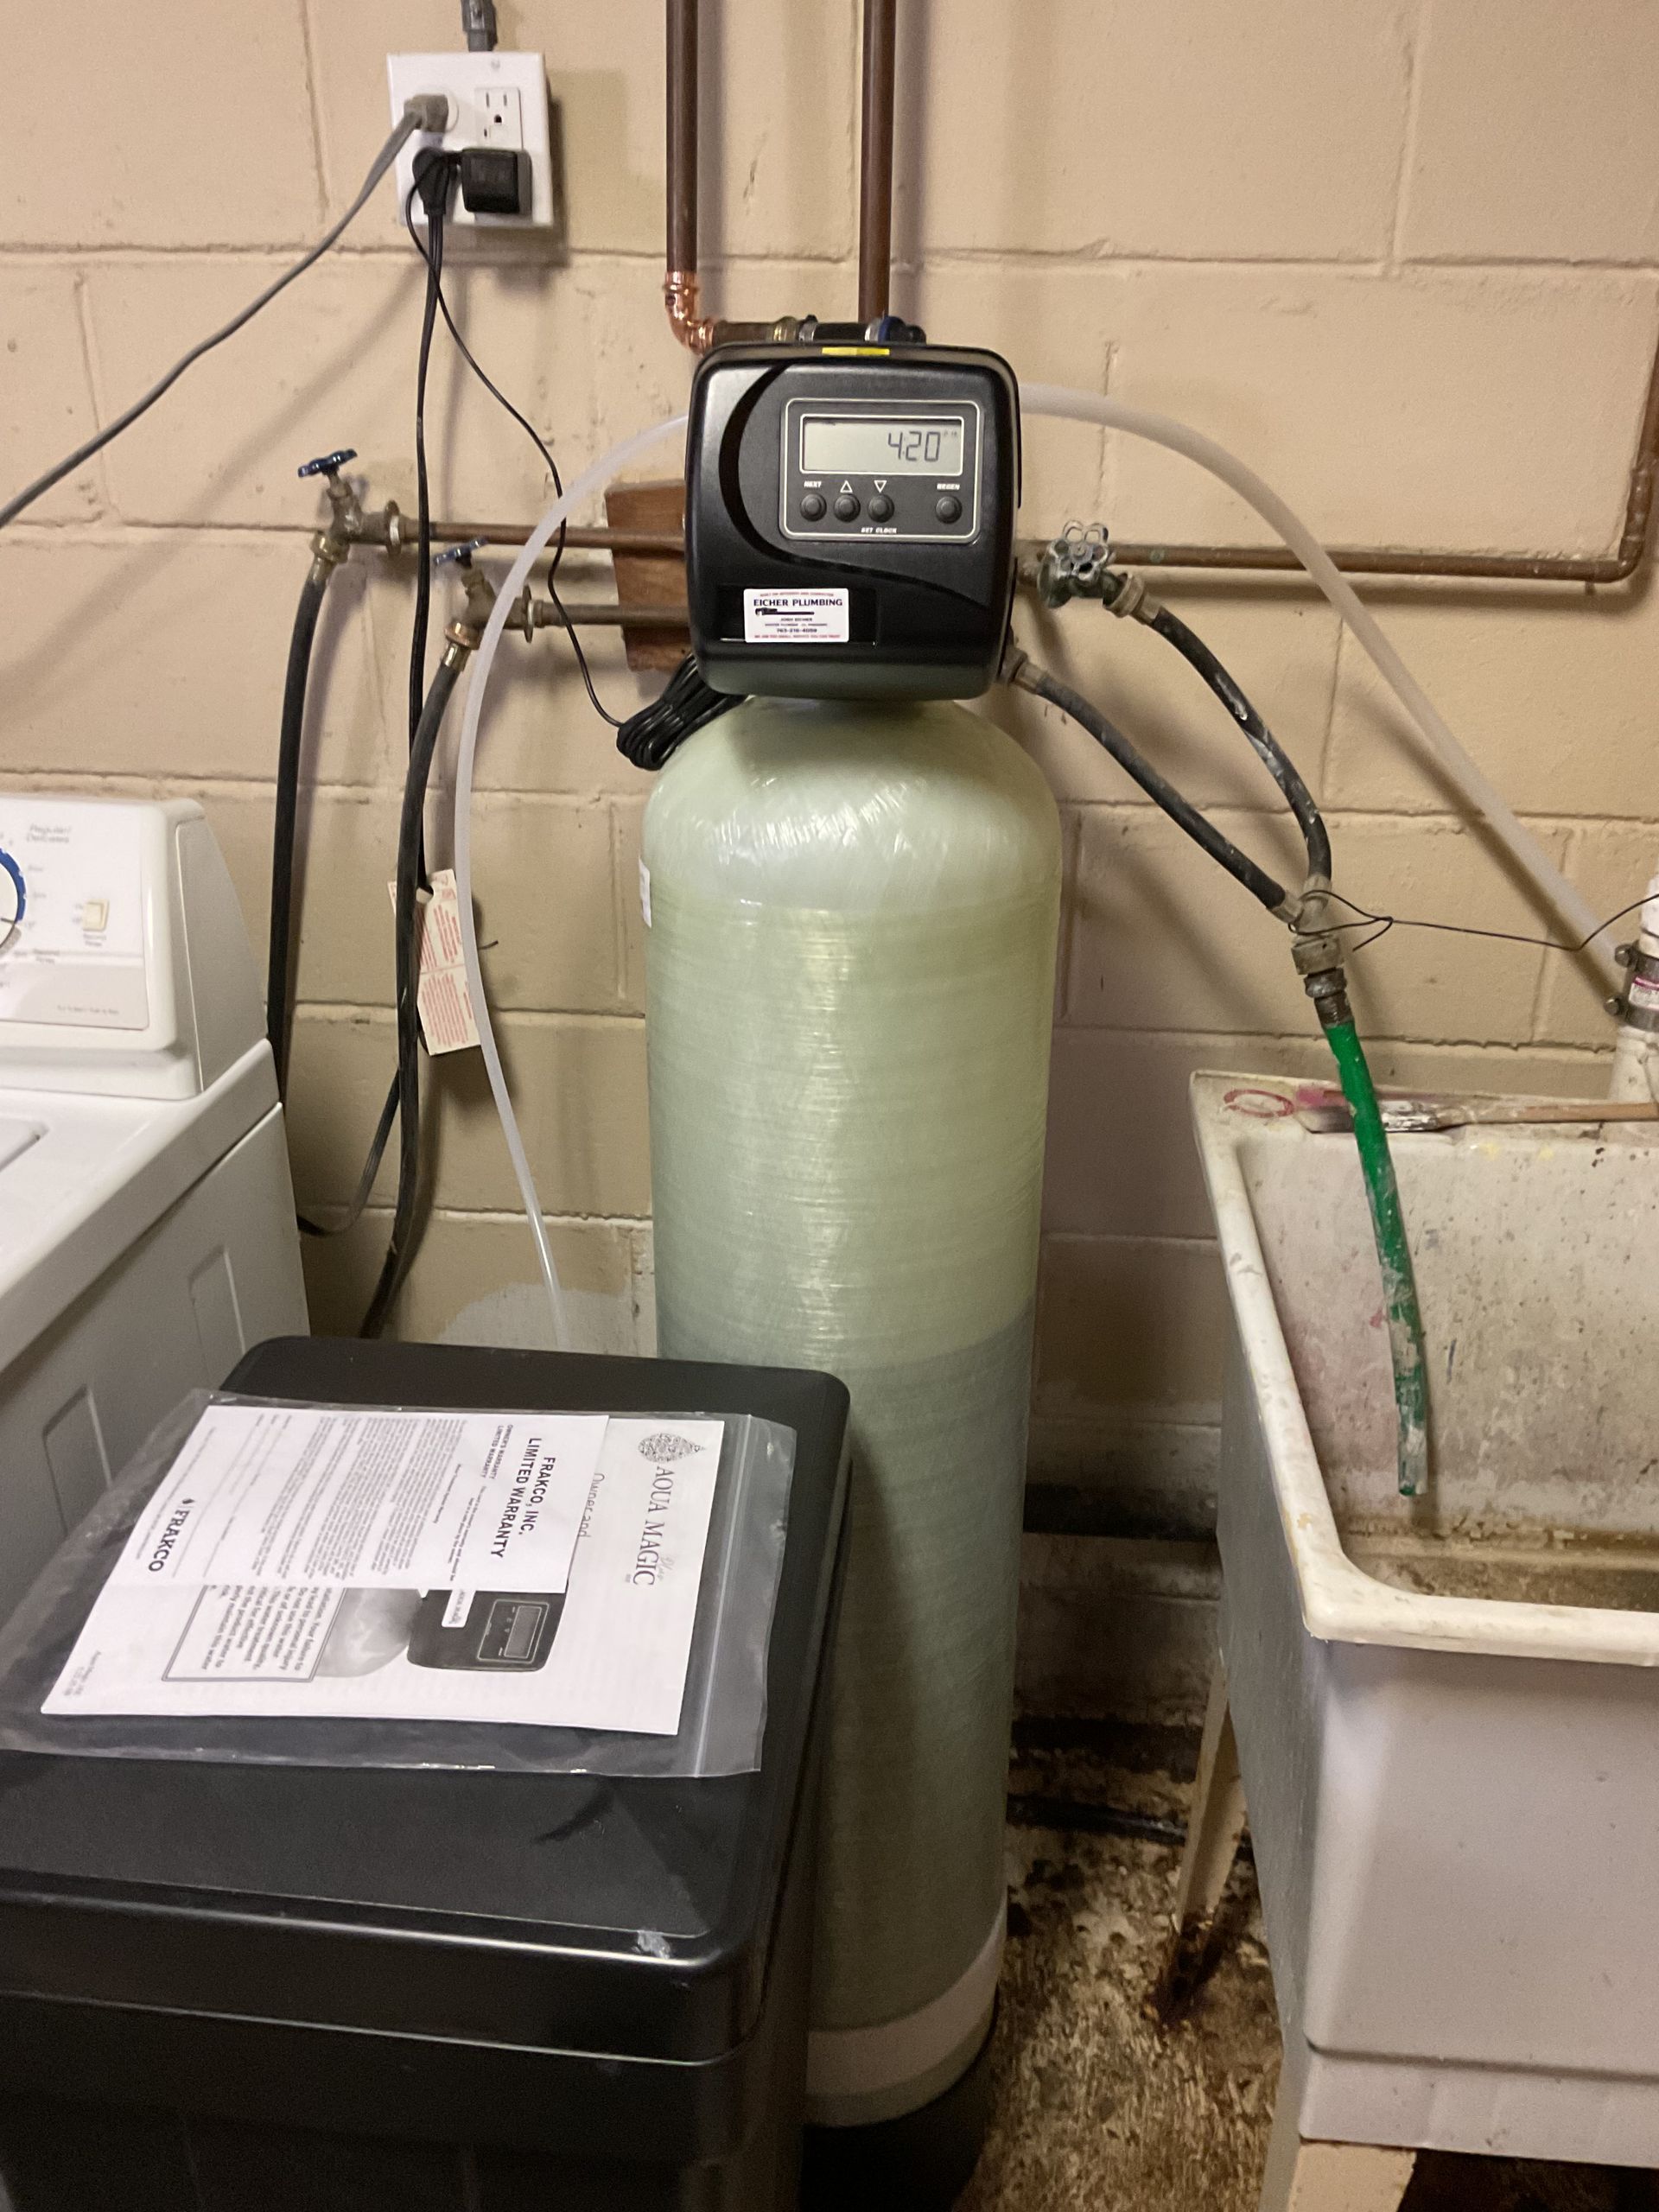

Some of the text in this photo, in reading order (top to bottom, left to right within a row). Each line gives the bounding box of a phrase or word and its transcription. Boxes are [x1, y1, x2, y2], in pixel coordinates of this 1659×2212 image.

[792, 598, 843, 607] PLUMBING
[480, 1426, 504, 1478] LIMITED WARRANTY
[489, 1449, 505, 1479] WARRANTY
[491, 1438, 542, 1558] LIMITED WARRANTY
[518, 1457, 556, 1535] FRAKCO, INC.
[148, 1510, 190, 1573] FRAKCO
[632, 1466, 675, 1586] AQUA MAGIC
[218, 1602, 234, 1633] maintain
[229, 1608, 245, 1637] product
[261, 1605, 272, 1624] water
[267, 1610, 283, 1642] unknown
[220, 1637, 232, 1658] water
[237, 1618, 254, 1649] effective
[245, 1626, 264, 1662] treatment
[273, 1637, 283, 1657] water
[289, 1618, 306, 1649] personal
[201, 1649, 214, 1670] water
